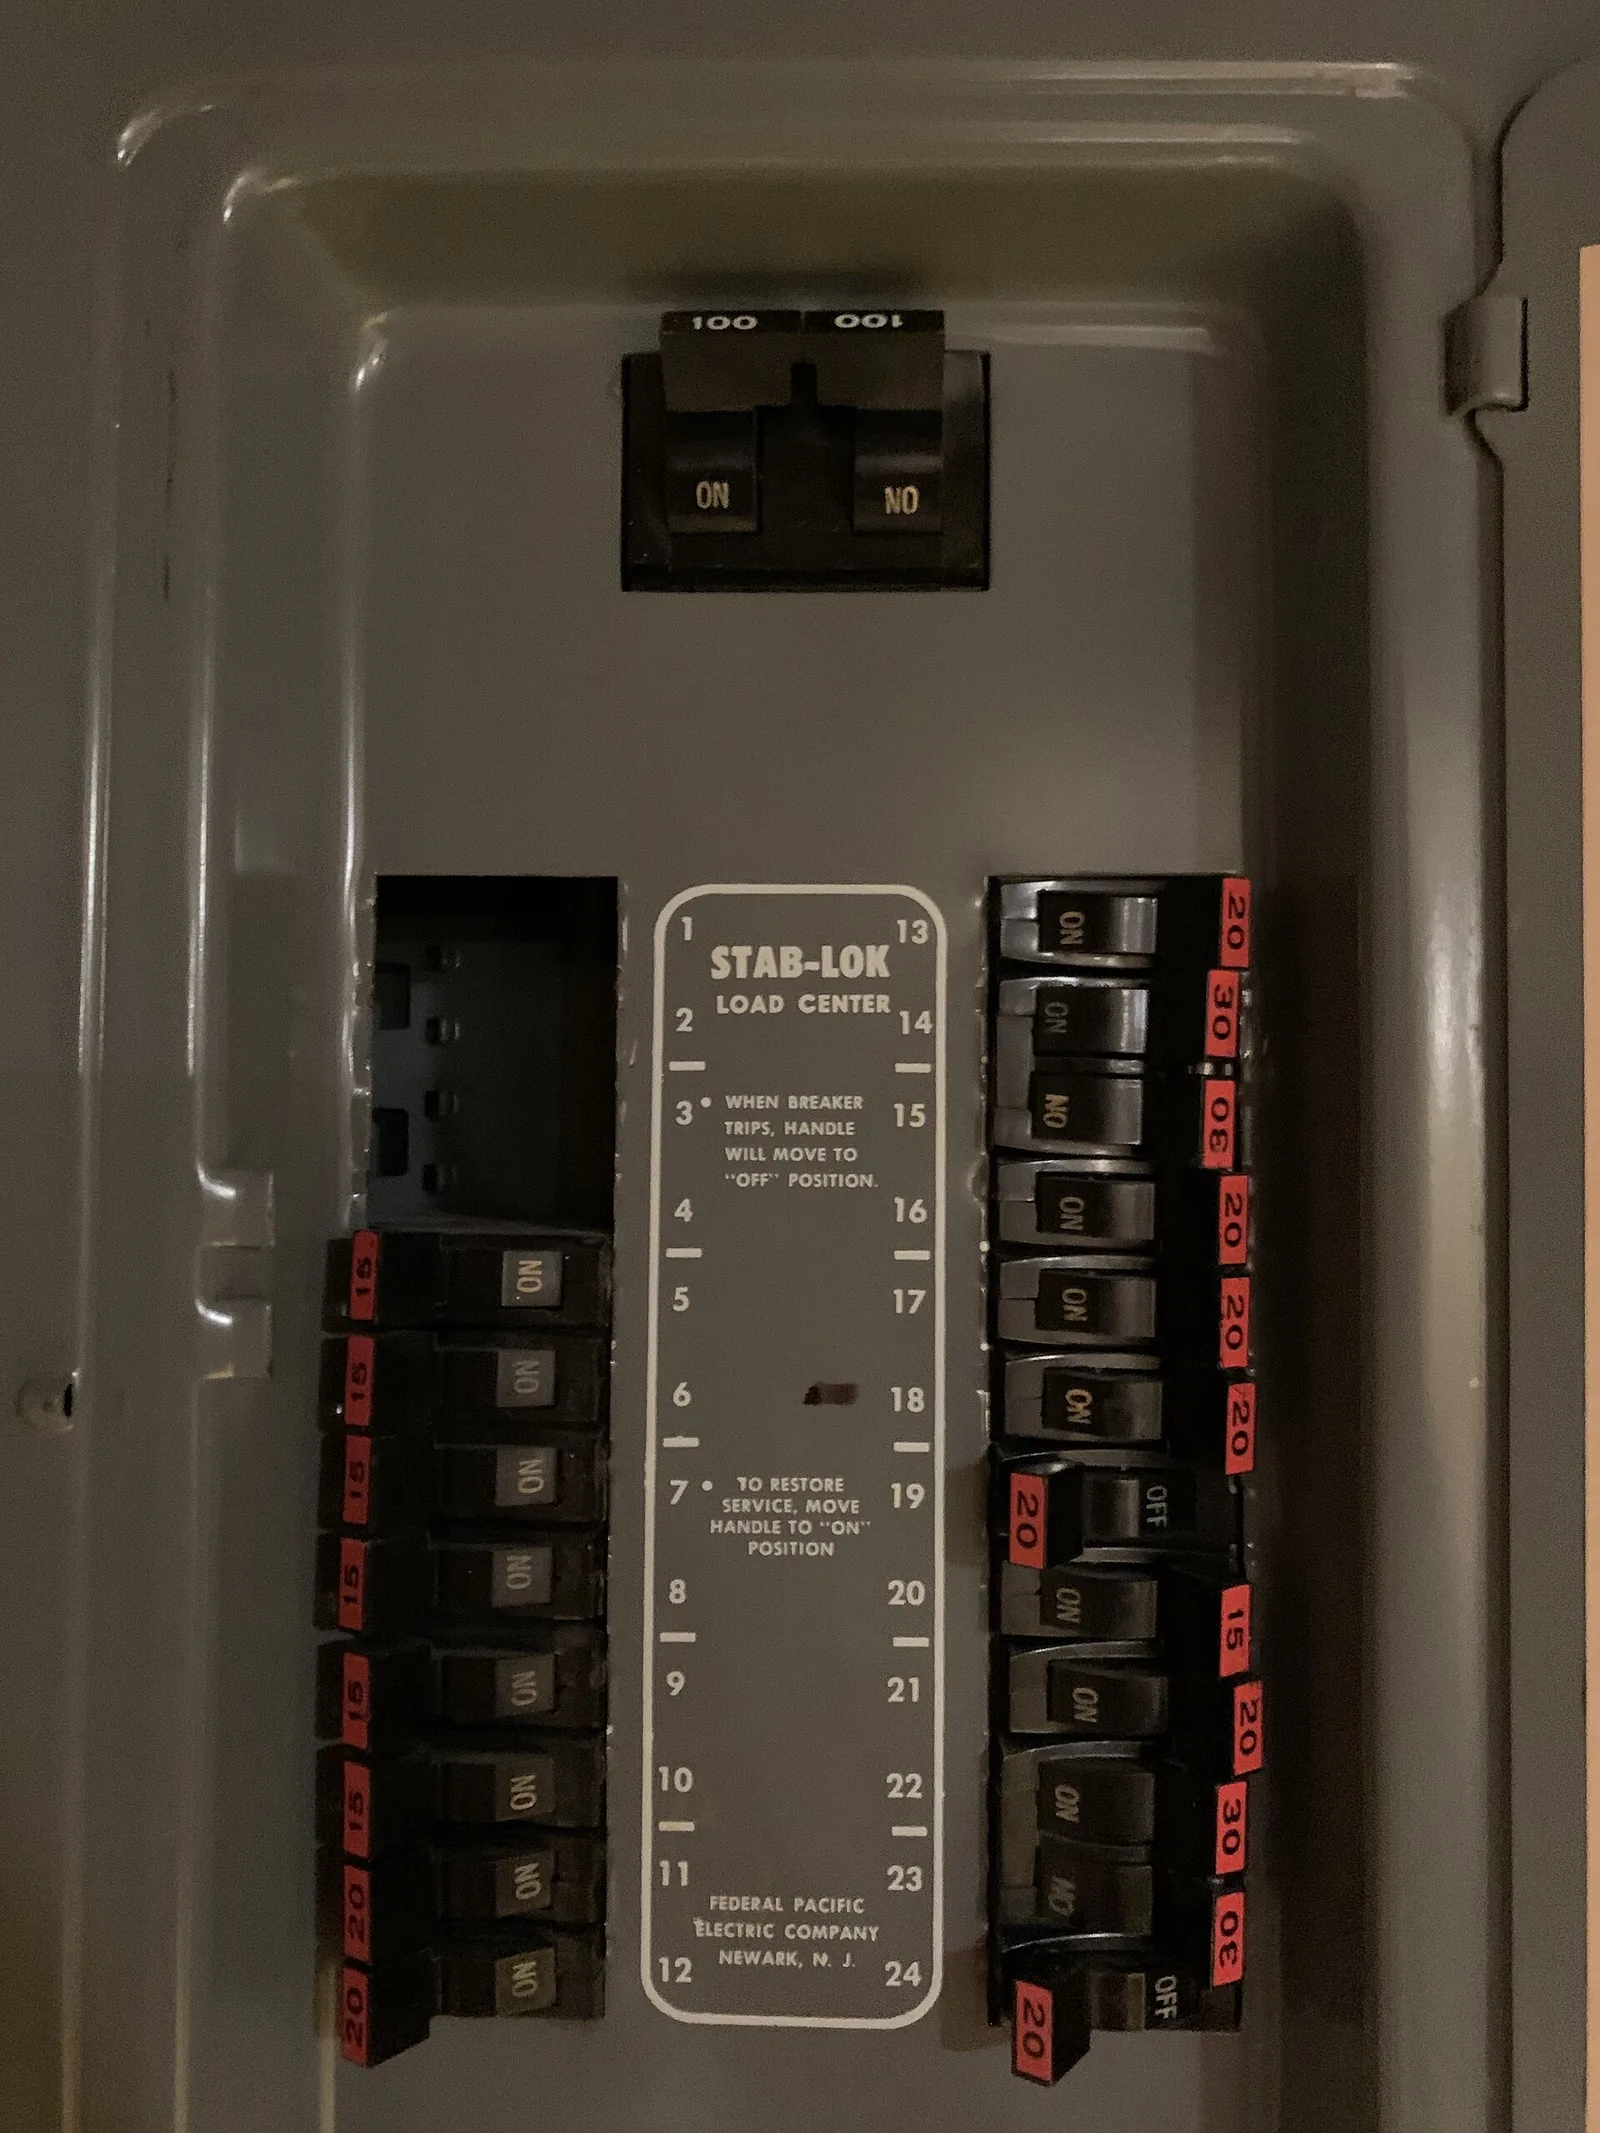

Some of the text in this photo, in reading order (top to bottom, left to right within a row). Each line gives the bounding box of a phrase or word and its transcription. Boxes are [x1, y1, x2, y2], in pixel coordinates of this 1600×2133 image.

[693, 315, 758, 331] 100
[696, 481, 730, 510] ON
[681, 916, 693, 941] 1
[897, 919, 929, 945] 13
[1058, 911, 1085, 945] ON
[1227, 892, 1245, 950] 20
[710, 945, 890, 980] STAB-LOK
[675, 1008, 693, 1032] 2
[716, 994, 890, 1014] LOAD CENTER
[1044, 1002, 1068, 1034] ON
[1212, 984, 1234, 1040] 30
[900, 1010, 933, 1034] 14
[676, 1101, 693, 1126] 3
[725, 1095, 863, 1110] WHEN BREAKER
[894, 1103, 925, 1128] 15
[1042, 1094, 1070, 1128] ON
[725, 1121, 855, 1137] TRIPS, HANDLE
[1209, 1097, 1230, 1152] 30
[725, 1147, 858, 1161] WILL MOVE TO
[725, 1173, 879, 1188] "OFF" POSITION.
[674, 1198, 693, 1222] 4
[894, 1196, 927, 1223] 16
[1059, 1196, 1085, 1231] ON
[1224, 1193, 1243, 1247] 20
[355, 1257, 372, 1297] 15
[516, 1259, 542, 1293] ON
[672, 1286, 689, 1312] 5
[893, 1288, 926, 1314] 17
[1062, 1288, 1088, 1322] ON
[1225, 1295, 1243, 1350] 20
[351, 1362, 366, 1401] 15
[513, 1360, 540, 1394] ON
[672, 1381, 691, 1407] 6
[890, 1386, 925, 1413] 18
[1065, 1388, 1093, 1424] ON
[1231, 1400, 1249, 1456] 20
[349, 1460, 364, 1497] 15
[517, 1459, 544, 1495] ON
[670, 1480, 689, 1505] 7
[737, 1476, 844, 1493] TO RESTORE
[722, 1499, 859, 1515] SERVICE, MOVE
[891, 1483, 925, 1509] 19
[1146, 1485, 1169, 1528] OFF
[710, 1519, 872, 1535] HANDLE TO "ON"
[1016, 1490, 1039, 1549] 20
[748, 1541, 834, 1556] POSITION
[343, 1565, 359, 1605] 15
[506, 1555, 532, 1591] ON
[669, 1579, 686, 1604] 8
[887, 1580, 925, 1606] 20
[1056, 1587, 1081, 1623] ON
[1226, 1609, 1244, 1650] 15
[511, 1670, 537, 1706] ON
[666, 1671, 685, 1696] 9
[887, 1677, 920, 1702] 21
[347, 1682, 363, 1721] 15
[1072, 1687, 1099, 1723] ON
[1239, 1700, 1257, 1755] 20
[509, 1774, 536, 1811] ON
[658, 1766, 693, 1792] 10
[885, 1773, 922, 1799] 22
[348, 1791, 364, 1833] 15
[1054, 1784, 1080, 1824] ON
[1222, 1799, 1241, 1856] 30
[514, 1862, 542, 1900] ON
[659, 1860, 688, 1886] 11
[886, 1865, 922, 1892] 23
[347, 1883, 365, 1941] 20
[710, 1896, 865, 1914] FEDERAL PACIFIC
[693, 1918, 880, 1942] ELECTRIC COMPANY
[1218, 1911, 1239, 1968] 30
[658, 1957, 692, 1983] 12
[719, 1950, 855, 1969] NEWARK, N. J.
[885, 1961, 921, 1987] 24
[511, 1961, 539, 1998] ON
[1154, 1975, 1177, 2020] OFF
[347, 1987, 364, 2048] 20
[1022, 1997, 1045, 2059] 20
